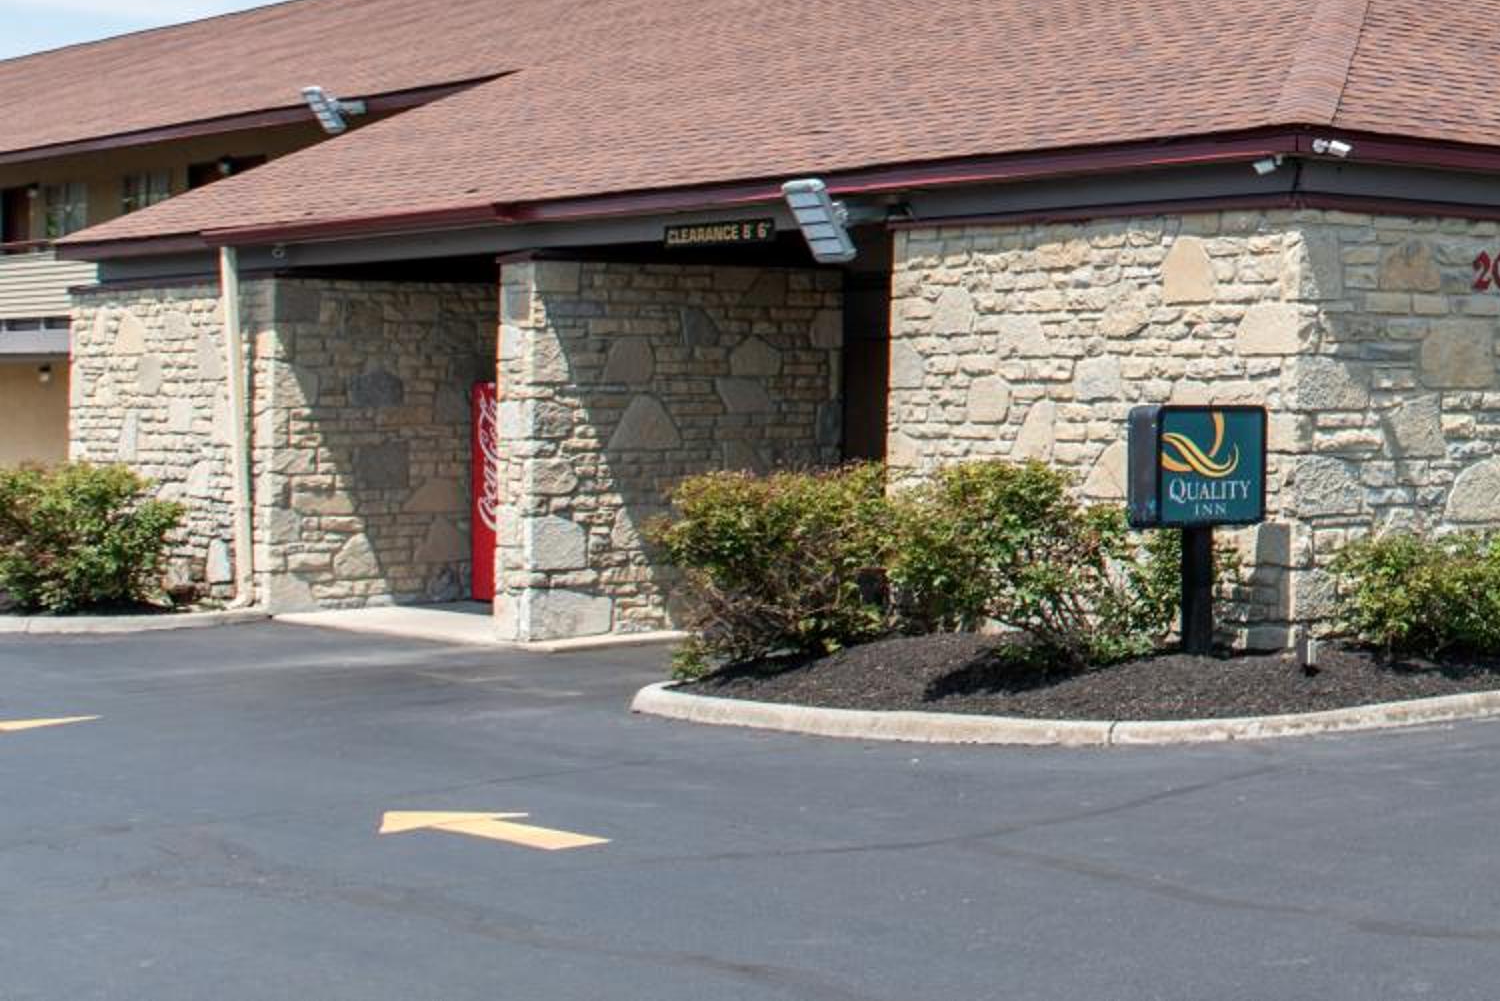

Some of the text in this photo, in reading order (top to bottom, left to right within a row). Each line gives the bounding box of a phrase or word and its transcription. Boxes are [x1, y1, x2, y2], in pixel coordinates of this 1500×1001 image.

[667, 225, 739, 244] CLEARANCE
[1169, 478, 1251, 504] QUALITY
[1195, 503, 1227, 515] INN
